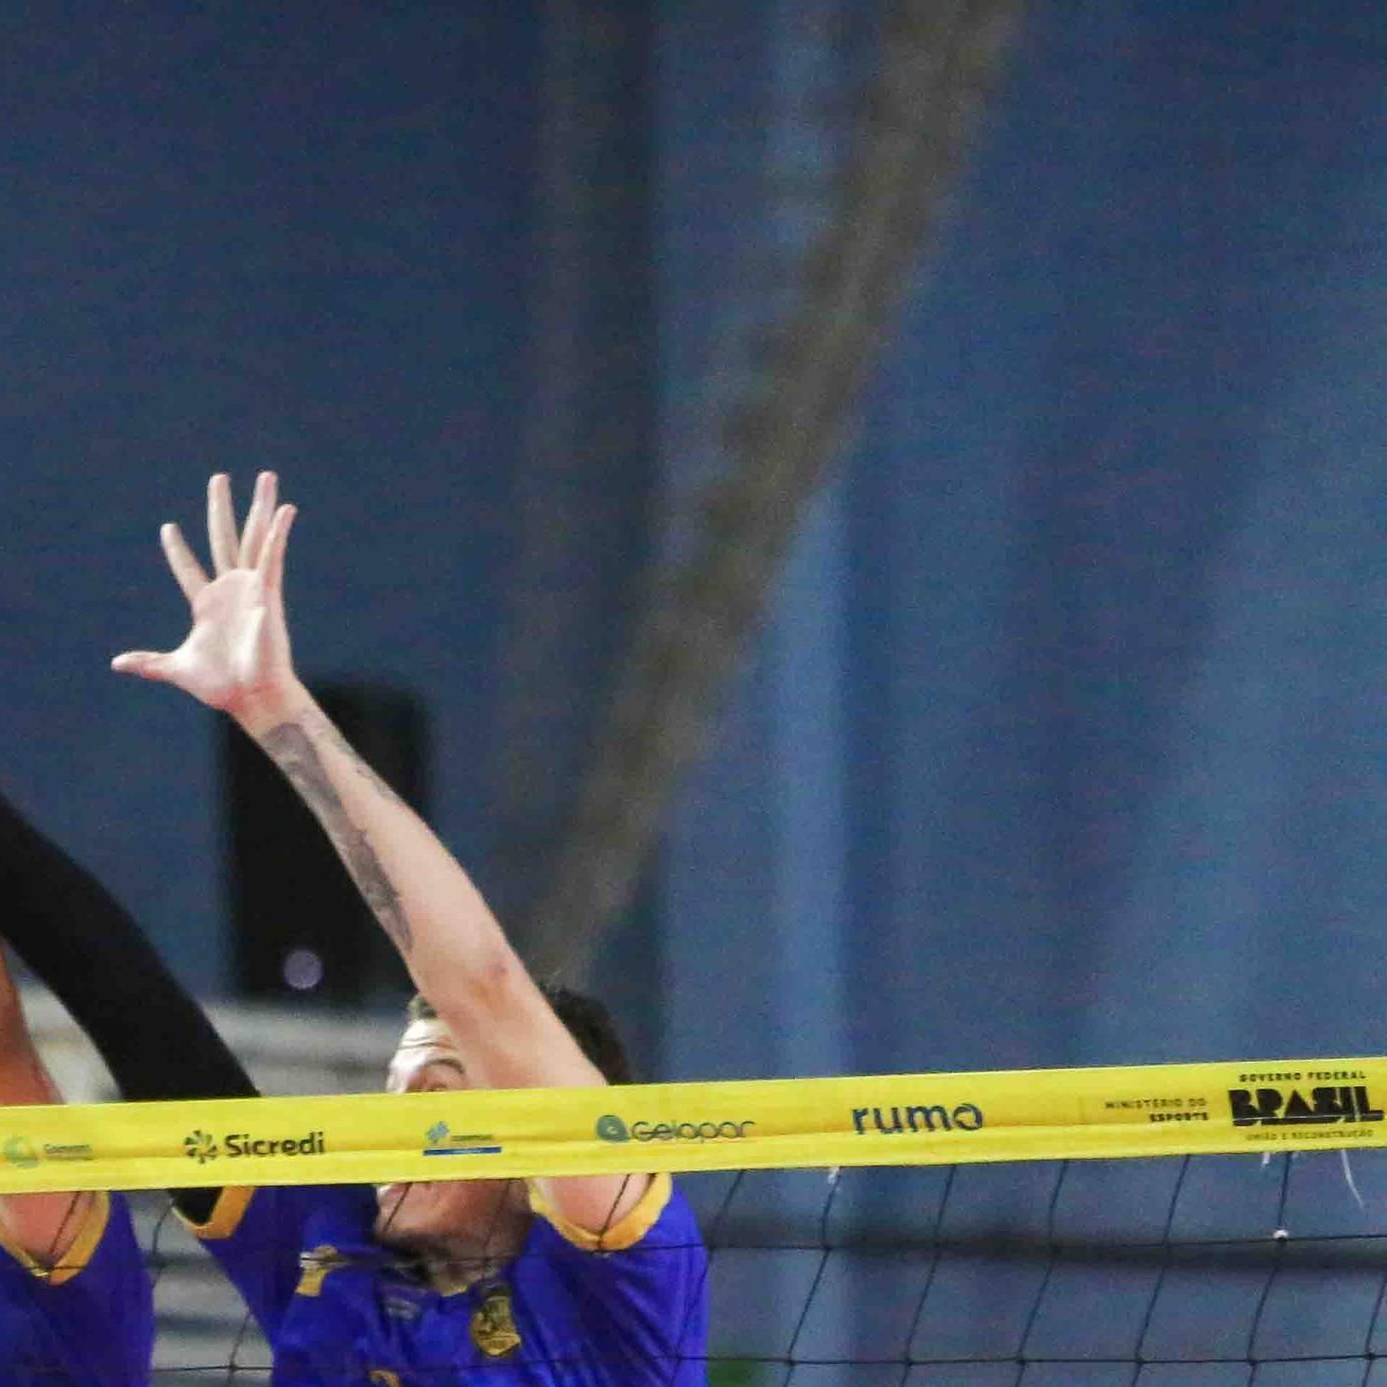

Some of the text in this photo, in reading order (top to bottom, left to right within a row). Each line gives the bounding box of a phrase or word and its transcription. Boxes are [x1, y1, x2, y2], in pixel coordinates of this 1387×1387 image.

[1239, 1070, 1367, 1083] GOVERNO FEDERAL
[852, 1103, 984, 1136] rumo
[1150, 1112, 1209, 1122] ESPORTE
[1228, 1086, 1385, 1127] BRASIL
[225, 1131, 325, 1158] Sicredi
